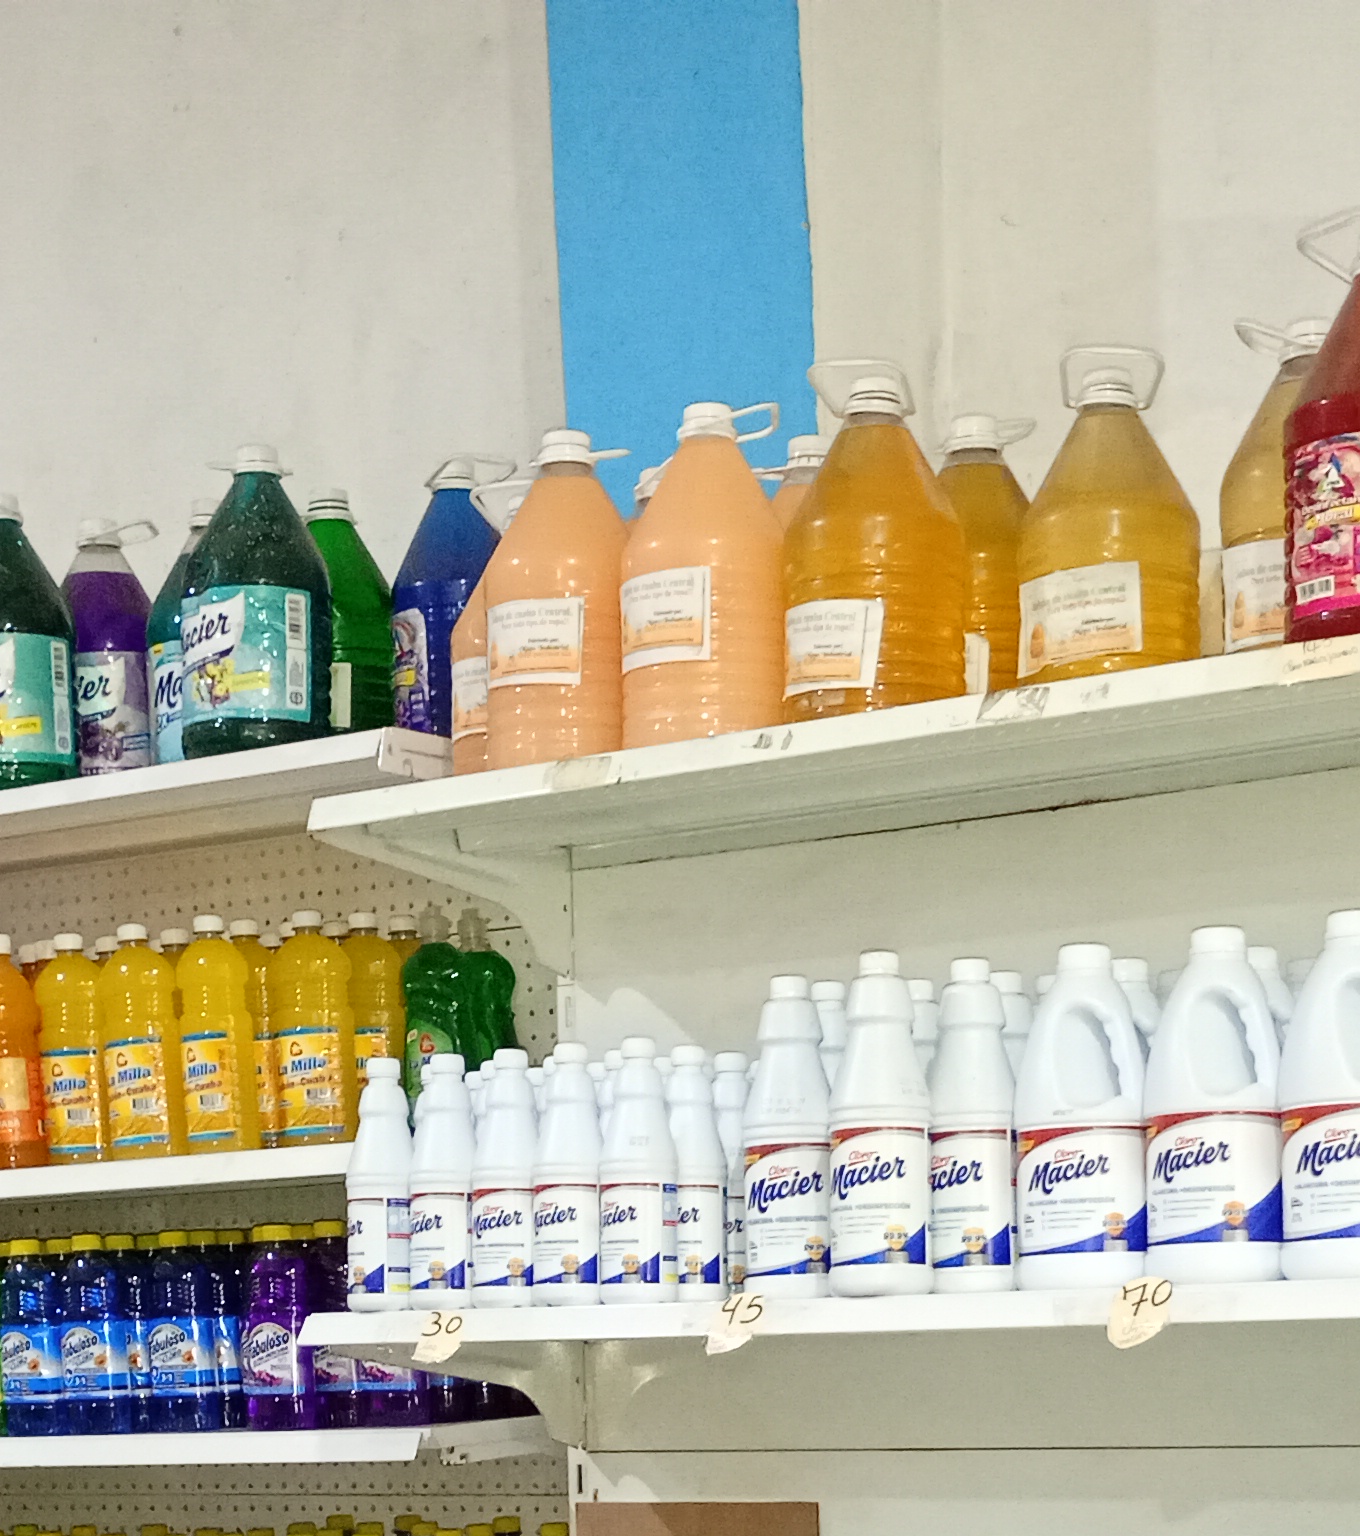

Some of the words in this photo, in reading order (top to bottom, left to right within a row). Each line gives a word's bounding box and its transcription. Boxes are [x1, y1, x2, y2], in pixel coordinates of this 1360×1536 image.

[52, 1078, 87, 1093] Milla
[117, 1066, 152, 1083] Milla
[187, 1062, 218, 1079] Milla
[829, 1155, 907, 1200] Macier
[931, 1160, 984, 1193] acier
[1027, 1153, 1111, 1195] Macier
[1152, 1138, 1231, 1184] Macier
[747, 1170, 824, 1213] Macier
[721, 1294, 764, 1325] 45
[1121, 1279, 1173, 1317] 70
[420, 1312, 464, 1337] 30
